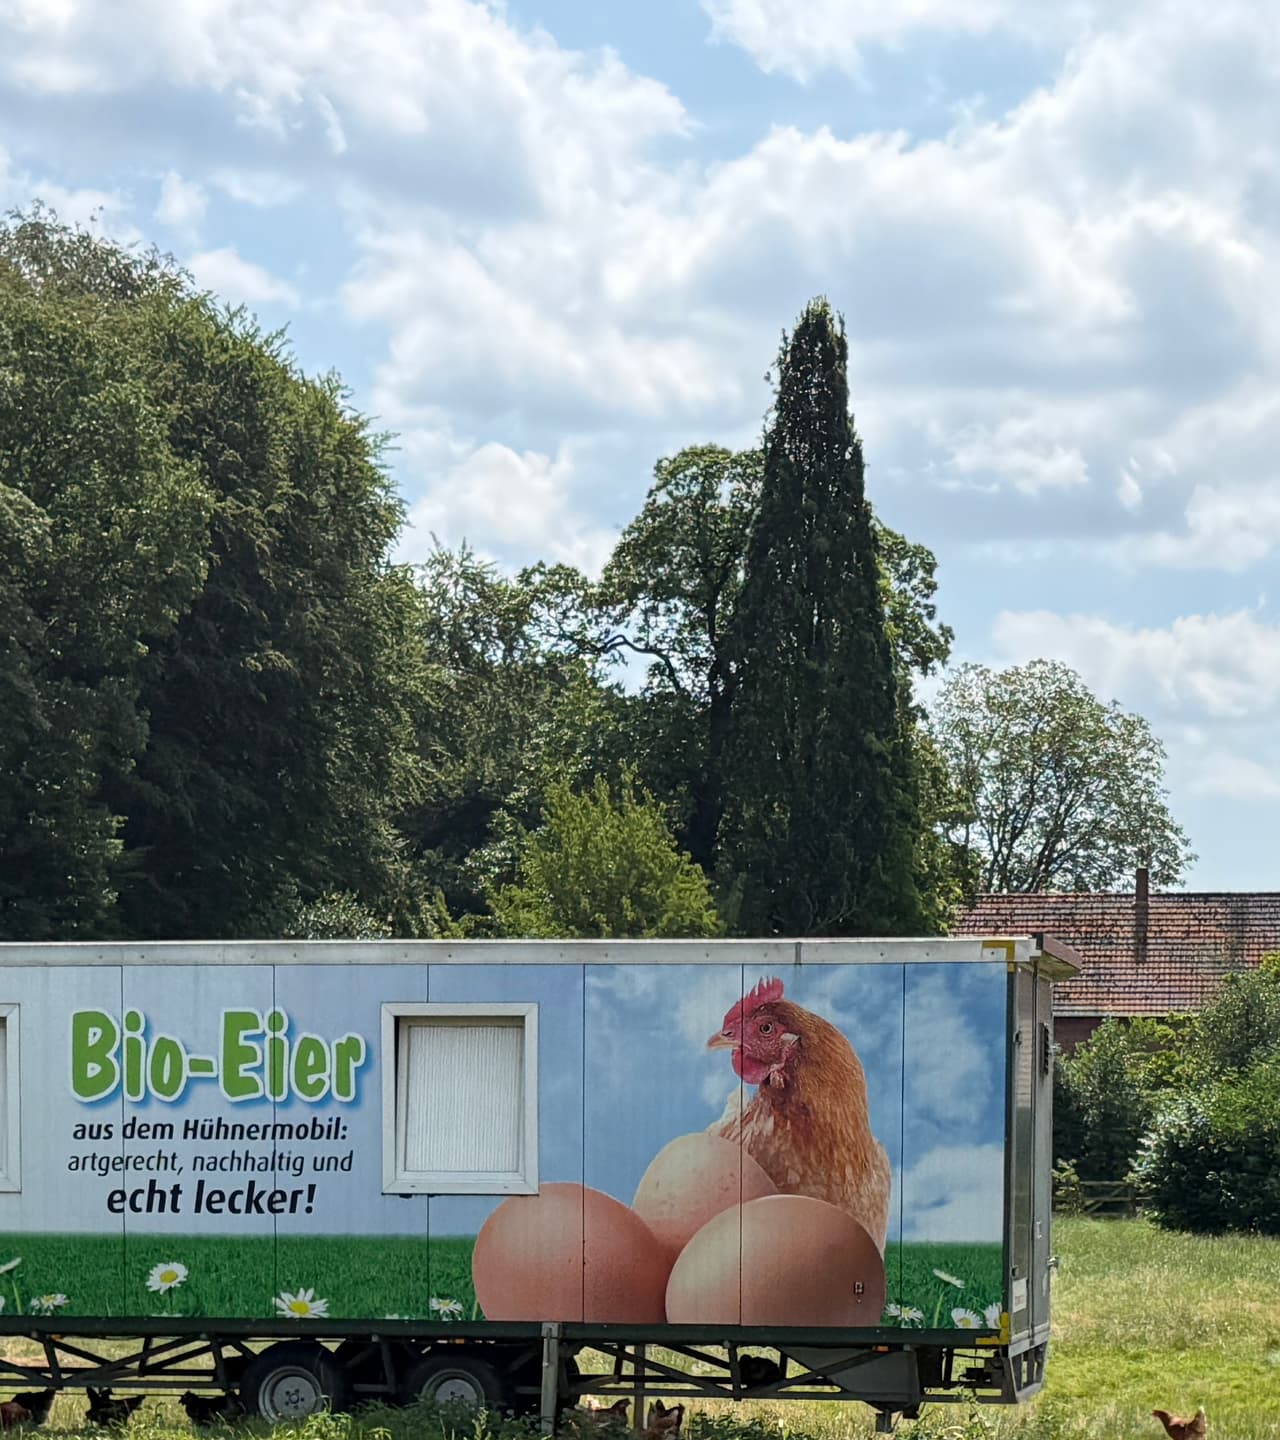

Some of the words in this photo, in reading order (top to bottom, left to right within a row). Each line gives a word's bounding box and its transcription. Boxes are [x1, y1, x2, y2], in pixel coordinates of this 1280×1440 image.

[70, 1007, 366, 1101] Bio-Eier
[72, 1121, 113, 1140] aus
[122, 1116, 174, 1141] dem
[183, 1116, 348, 1141] Hühnermobil:
[67, 1150, 184, 1176] artgerecht,
[192, 1150, 305, 1177] nachhaltig
[312, 1150, 354, 1172] und
[107, 1179, 183, 1214] echt
[193, 1180, 317, 1214] lecker!
